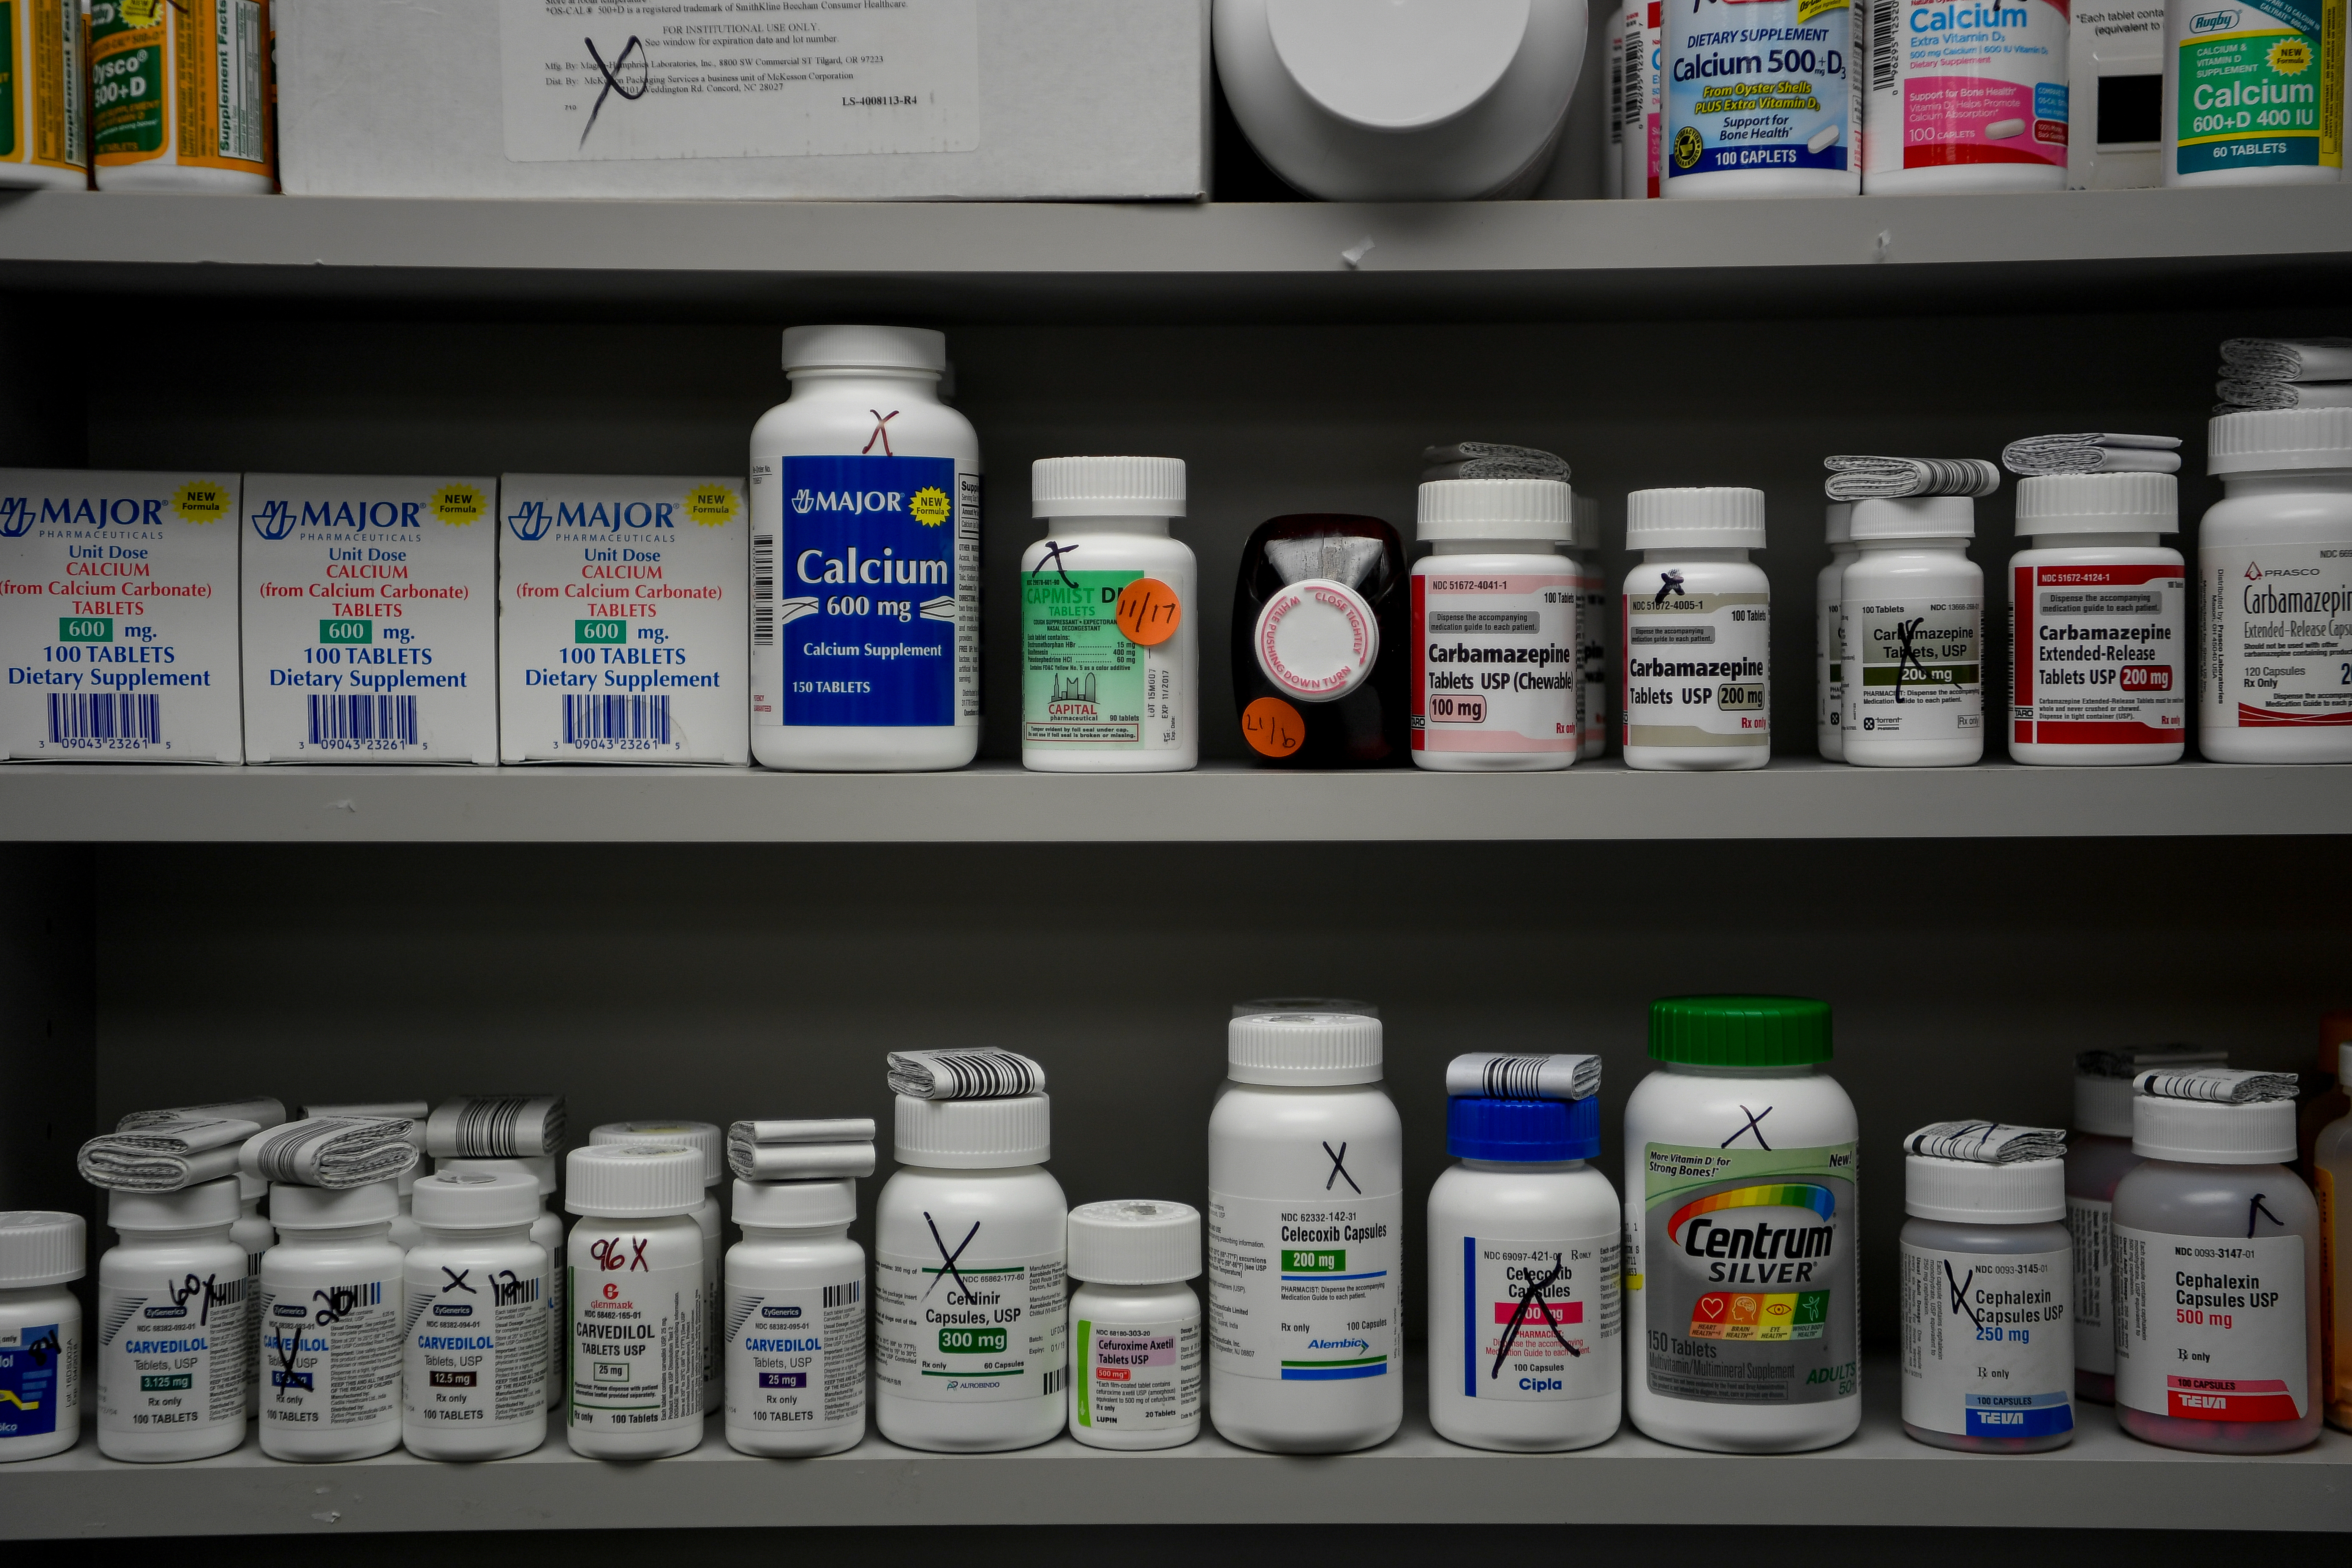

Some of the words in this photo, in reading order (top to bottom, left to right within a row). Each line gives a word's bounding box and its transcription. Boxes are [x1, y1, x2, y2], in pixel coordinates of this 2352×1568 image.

[1910, 3, 2026, 33] Calcium
[2195, 11, 2232, 32] Rugby
[663, 26, 683, 34] FOR
[686, 24, 763, 34] INSTITUTIONAL
[767, 23, 786, 32] USE
[788, 22, 819, 31] ONLY.
[645, 38, 660, 46] See
[662, 38, 696, 46] window
[712, 36, 754, 46] expiration
[756, 36, 773, 44] date
[776, 35, 790, 44] and
[806, 35, 839, 43] number.
[1688, 30, 1739, 48] DIETARY
[1740, 28, 1829, 43] SUPPLEMENT
[2281, 48, 2302, 57] NEW
[1674, 52, 1761, 82] Calcium
[1767, 49, 1815, 73] 500
[220, 49, 231, 151] Supplement
[842, 95, 917, 106] LS-4008113-R4
[2193, 79, 2314, 110] Calcium
[1909, 127, 1935, 142] 100
[1937, 130, 1975, 140] CAPLETS
[1716, 152, 1736, 165] 100
[1741, 150, 1797, 164] CAPLETS
[2213, 147, 2228, 158] 60
[2230, 143, 2287, 156] TABLETS
[920, 497, 942, 506] NEW
[916, 506, 945, 516] Formula
[39, 530, 163, 539] PHARMACEUTICALS
[329, 547, 362, 561] Unit
[368, 548, 406, 561] Dose
[66, 562, 150, 576] CALCIUM
[796, 547, 947, 584] Calcium
[2265, 569, 2319, 577] PRASCO
[1433, 581, 1447, 590] NDC
[1450, 580, 1507, 590] 51672-4041-1
[2058, 574, 2110, 582] 51672-4124-1
[260, 583, 303, 599] (from
[309, 583, 375, 598] Calcium
[380, 584, 469, 601] Carbonate)
[1027, 588, 1094, 604] CAPMIST
[588, 604, 656, 617] TABLETS
[827, 596, 869, 616] 600
[877, 599, 912, 622] mg
[1119, 592, 1176, 632] 11/17
[1271, 595, 1301, 622] WHILE
[1315, 592, 1347, 612] CLOSE
[1345, 609, 1363, 654] TIGHTLY
[1478, 614, 1527, 622] accompanying
[329, 623, 363, 638] 600
[2039, 623, 2171, 644] Carbamazepine
[44, 646, 81, 662] 100
[86, 646, 174, 664] TABLETS
[1266, 623, 1285, 672] PUSHING
[1429, 642, 1570, 668] Carbamazepine
[1942, 645, 1967, 656] USP
[2039, 644, 2156, 662] Extended-Release
[1322, 665, 1351, 686] TURN
[1630, 656, 1763, 681] Carbamazepine
[2245, 667, 2260, 676] 120
[2263, 667, 2306, 677] Capsules
[525, 669, 597, 691] Dietary
[604, 669, 720, 692] Supplement
[1284, 670, 1320, 688] DOWN
[1429, 672, 1474, 689] Tablets
[1481, 673, 1510, 690] USP
[1514, 672, 1573, 692] (Chewable)
[2123, 669, 2147, 684] 200
[2151, 671, 2169, 688] mg
[792, 682, 813, 692] 150
[815, 682, 870, 693] TABLETS
[1630, 687, 1673, 705] Tablets
[1682, 687, 1712, 704] USP
[1721, 687, 1744, 704] 200
[1748, 689, 1763, 707] mg
[1048, 704, 1097, 715] CAPITAL
[1432, 699, 1453, 716] 100
[1458, 703, 1482, 721] mg
[2015, 709, 2033, 717] TARO
[1741, 717, 1752, 728] Rx
[1754, 718, 1766, 730] only
[1829, 1151, 1853, 1168] New!
[1281, 1213, 1298, 1222] NDC
[1300, 1211, 1357, 1222] 62332-142-31
[1281, 1226, 1340, 1242] Celecoxib
[1344, 1223, 1387, 1243] Capsules
[590, 1237, 625, 1271] 96
[629, 1235, 648, 1273] X
[1293, 1253, 1315, 1267] 200
[1319, 1254, 1334, 1269] mg
[980, 1274, 1024, 1282] 65862-177-60
[2176, 1271, 2259, 1290] Cephalexin
[1976, 1289, 2051, 1307] Cephalexin
[2176, 1289, 2245, 1309] Capsules
[2250, 1292, 2278, 1308] USP
[926, 1308, 990, 1326] Capsules,
[994, 1308, 1021, 1323] USP
[2176, 1309, 2203, 1325] 500
[2209, 1313, 2232, 1329] mg
[577, 1322, 655, 1339] CARVEDILOL
[126, 1337, 208, 1353] CARVEDILOL
[418, 1335, 493, 1350] CARVEDILOL
[746, 1337, 822, 1351] CARVEDILOL
[942, 1332, 972, 1347] 300
[978, 1333, 1004, 1349] mg
[1098, 1340, 1148, 1350] Cefuroxime
[1150, 1339, 1173, 1350] Axetil
[1308, 1339, 1362, 1349] Alembic
[1648, 1330, 1668, 1351] 150
[1671, 1341, 1717, 1358] Tablets
[1098, 1354, 1129, 1364] Tablets
[1131, 1355, 1149, 1364] USP
[599, 1366, 608, 1374] 25
[610, 1367, 622, 1376] mg
[1530, 1364, 1564, 1373] Capsules
[1806, 1364, 1855, 1385] ADULTS
[144, 1377, 170, 1387] 3.125
[172, 1377, 188, 1388] mg
[435, 1374, 452, 1383] 12.5
[455, 1375, 470, 1384] mg
[1519, 1378, 1563, 1392] Cipla
[766, 1395, 777, 1403] Rx
[779, 1395, 797, 1405] only
[1993, 1397, 2032, 1405] CAPSULES
[2179, 1394, 2226, 1409] TEVA
[267, 1409, 276, 1420] 100
[279, 1410, 318, 1422] TABLETS
[1977, 1412, 2024, 1424] TEVA
